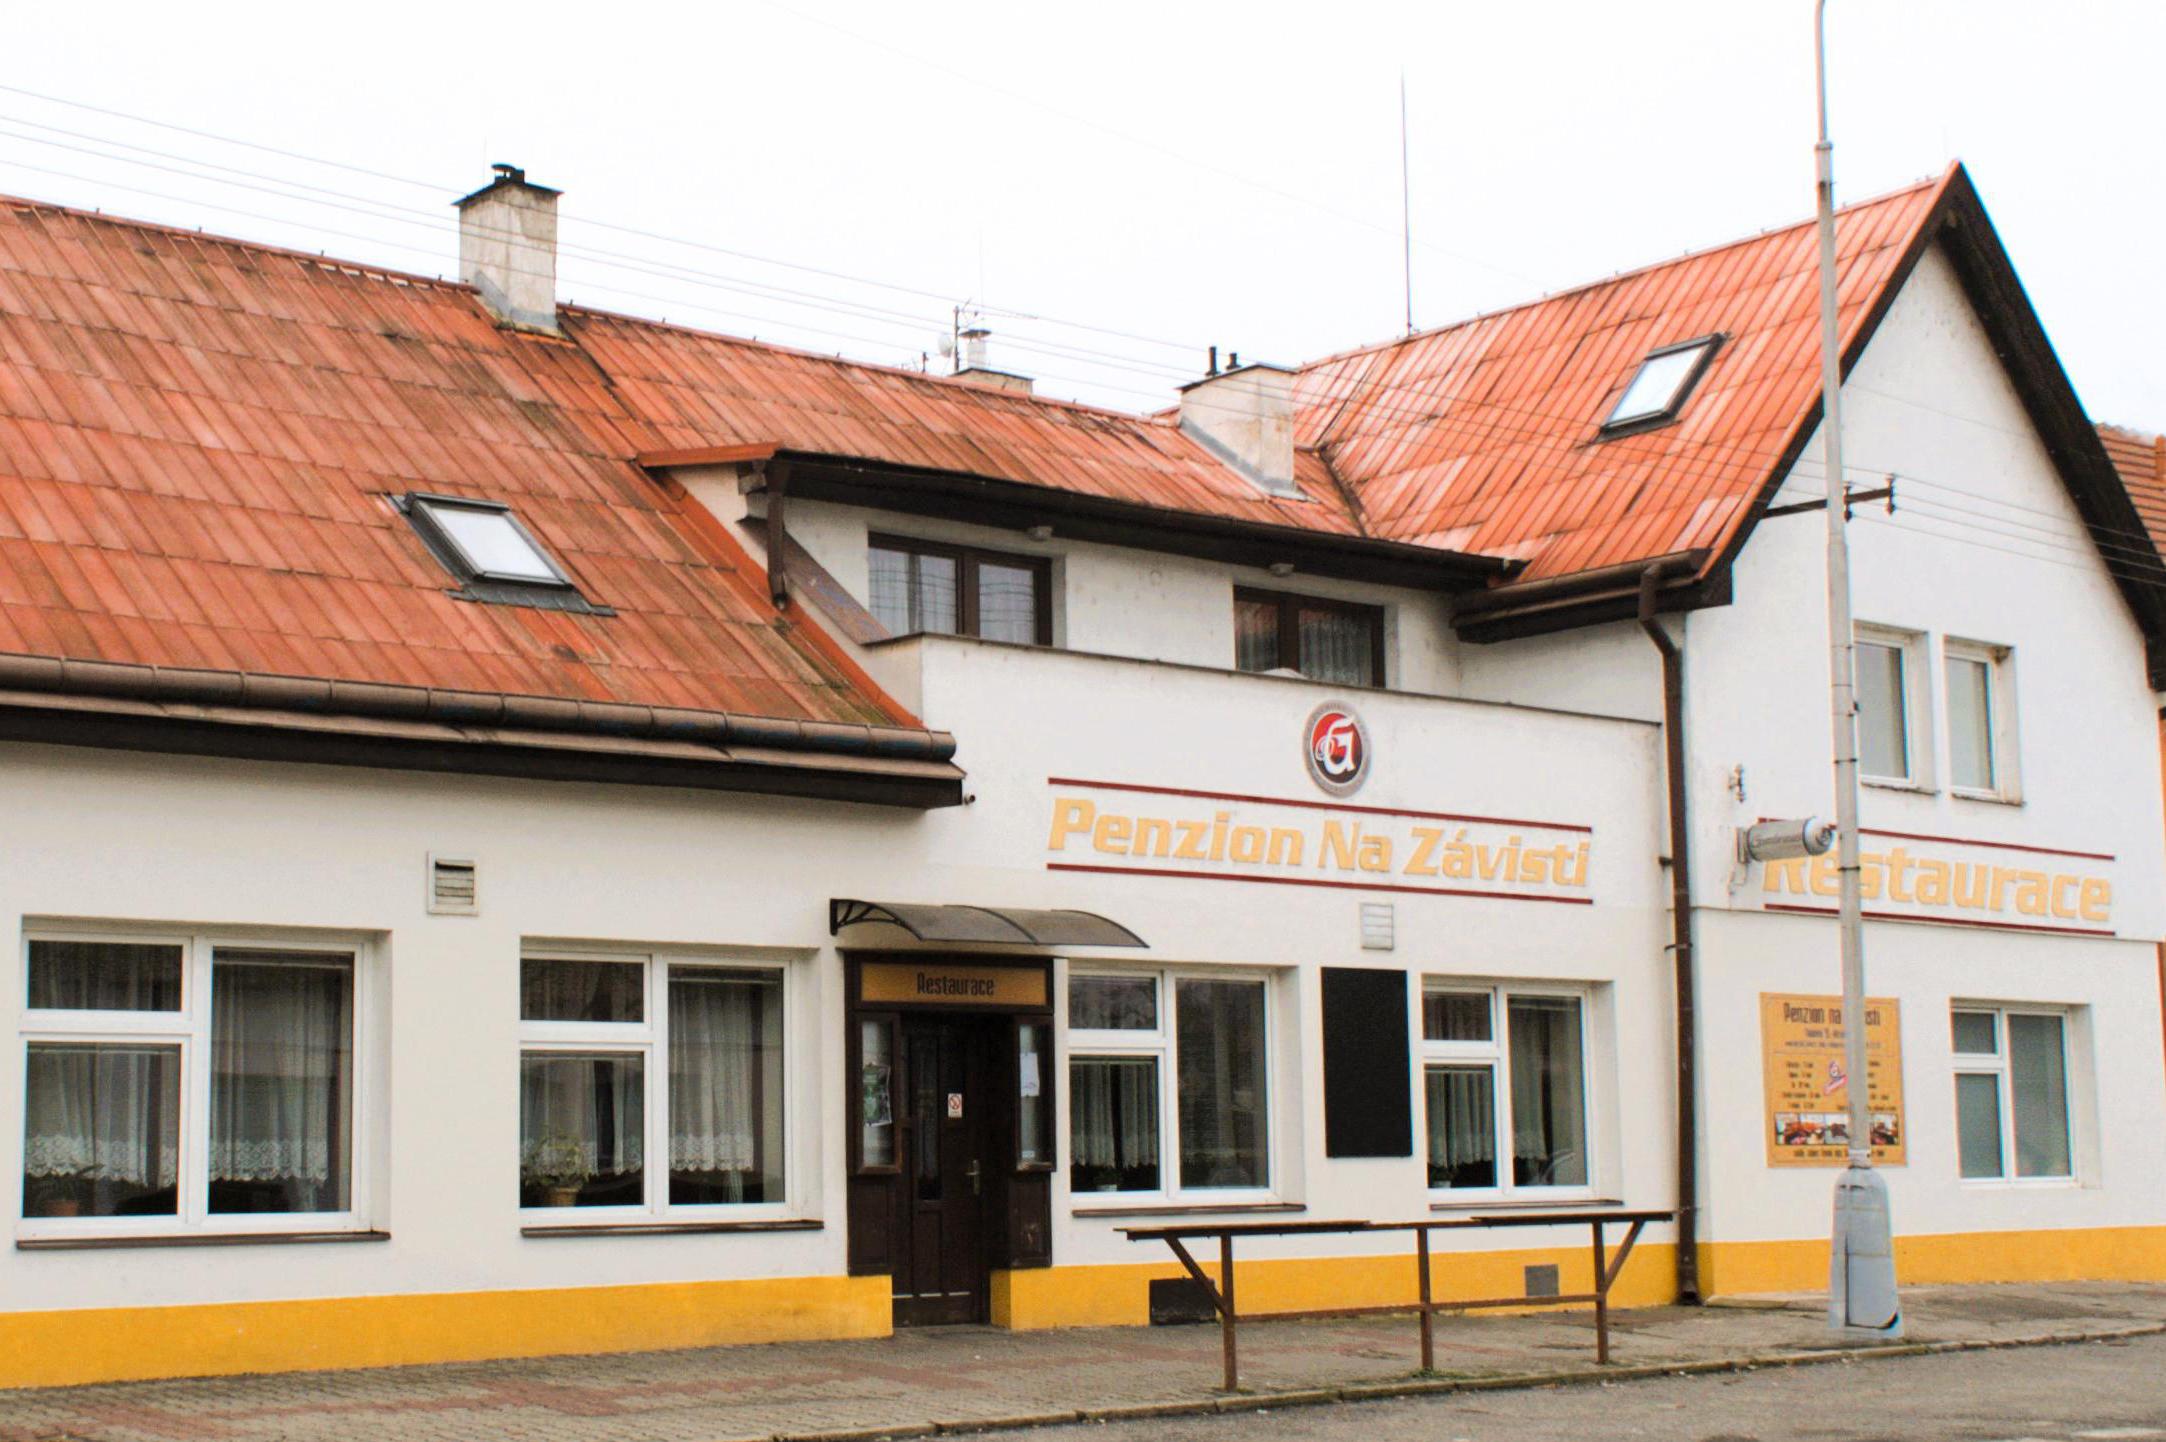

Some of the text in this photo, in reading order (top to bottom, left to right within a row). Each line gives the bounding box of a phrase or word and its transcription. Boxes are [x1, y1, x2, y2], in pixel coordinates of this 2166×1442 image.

[1047, 798, 1591, 887] Penzion Na Závisti
[917, 972, 995, 996] Restaurace
[1783, 1002, 1825, 1024] Penzion
